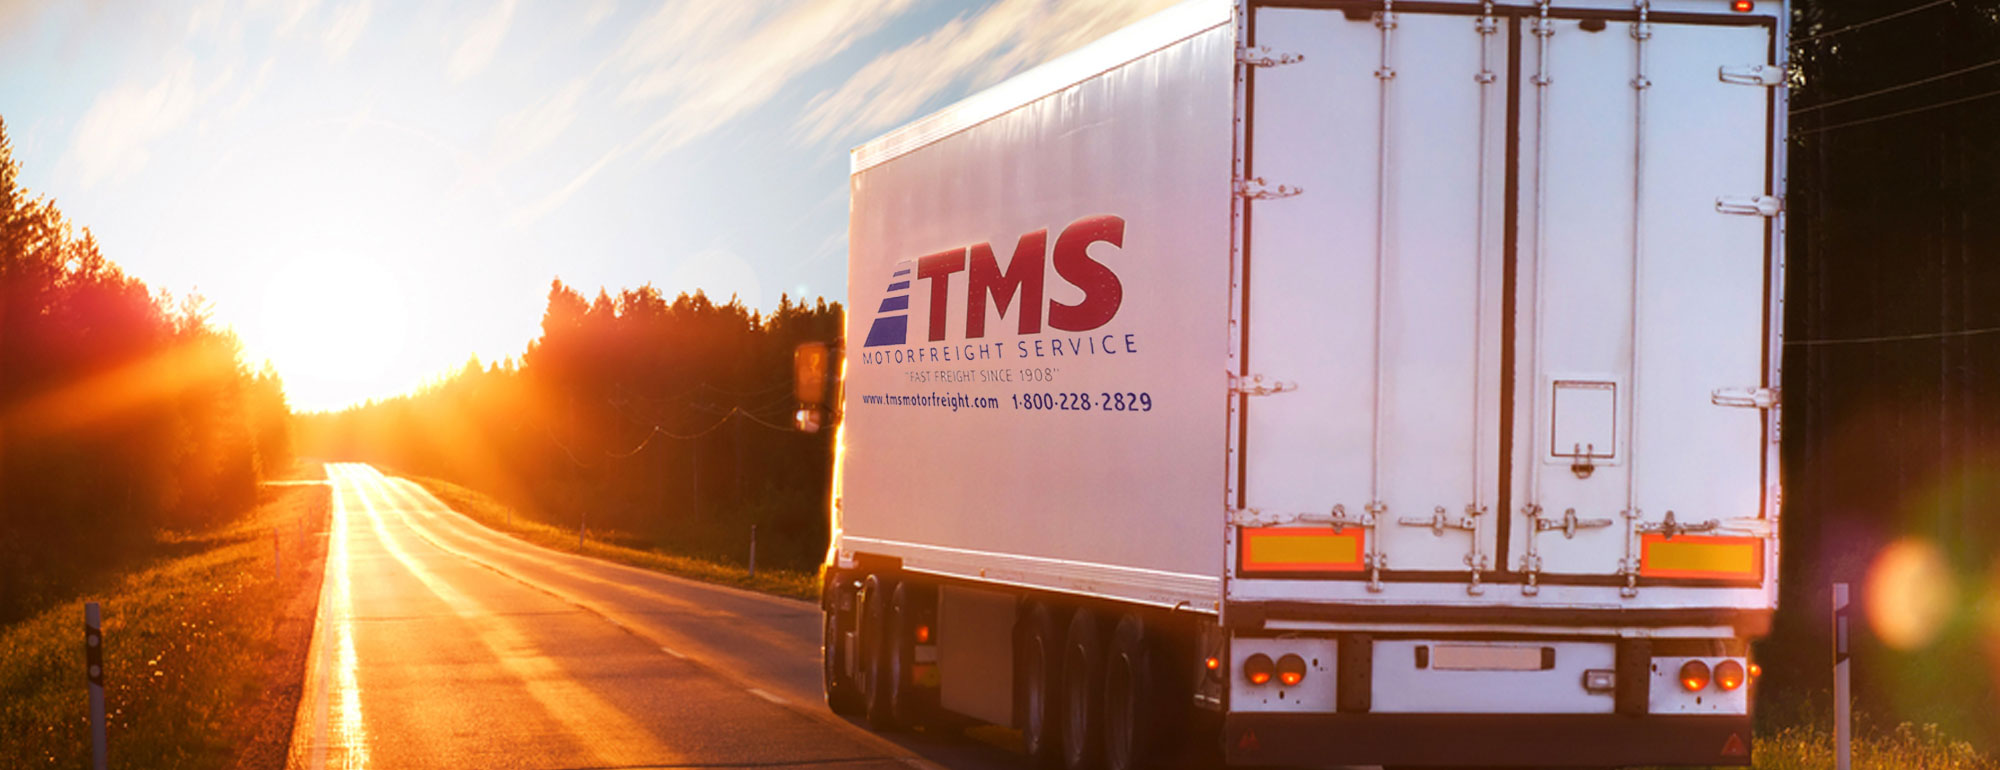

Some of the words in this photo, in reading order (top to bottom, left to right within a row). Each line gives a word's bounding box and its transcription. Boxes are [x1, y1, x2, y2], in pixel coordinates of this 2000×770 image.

[917, 214, 1125, 342] TMS
[863, 342, 1003, 364] MOTORFREIGHT
[1019, 334, 1137, 358] SERVICE
[934, 370, 976, 383] FREIGHT
[980, 369, 1012, 382] SINCE
[863, 392, 999, 412] www.tmsmotorfreight.com
